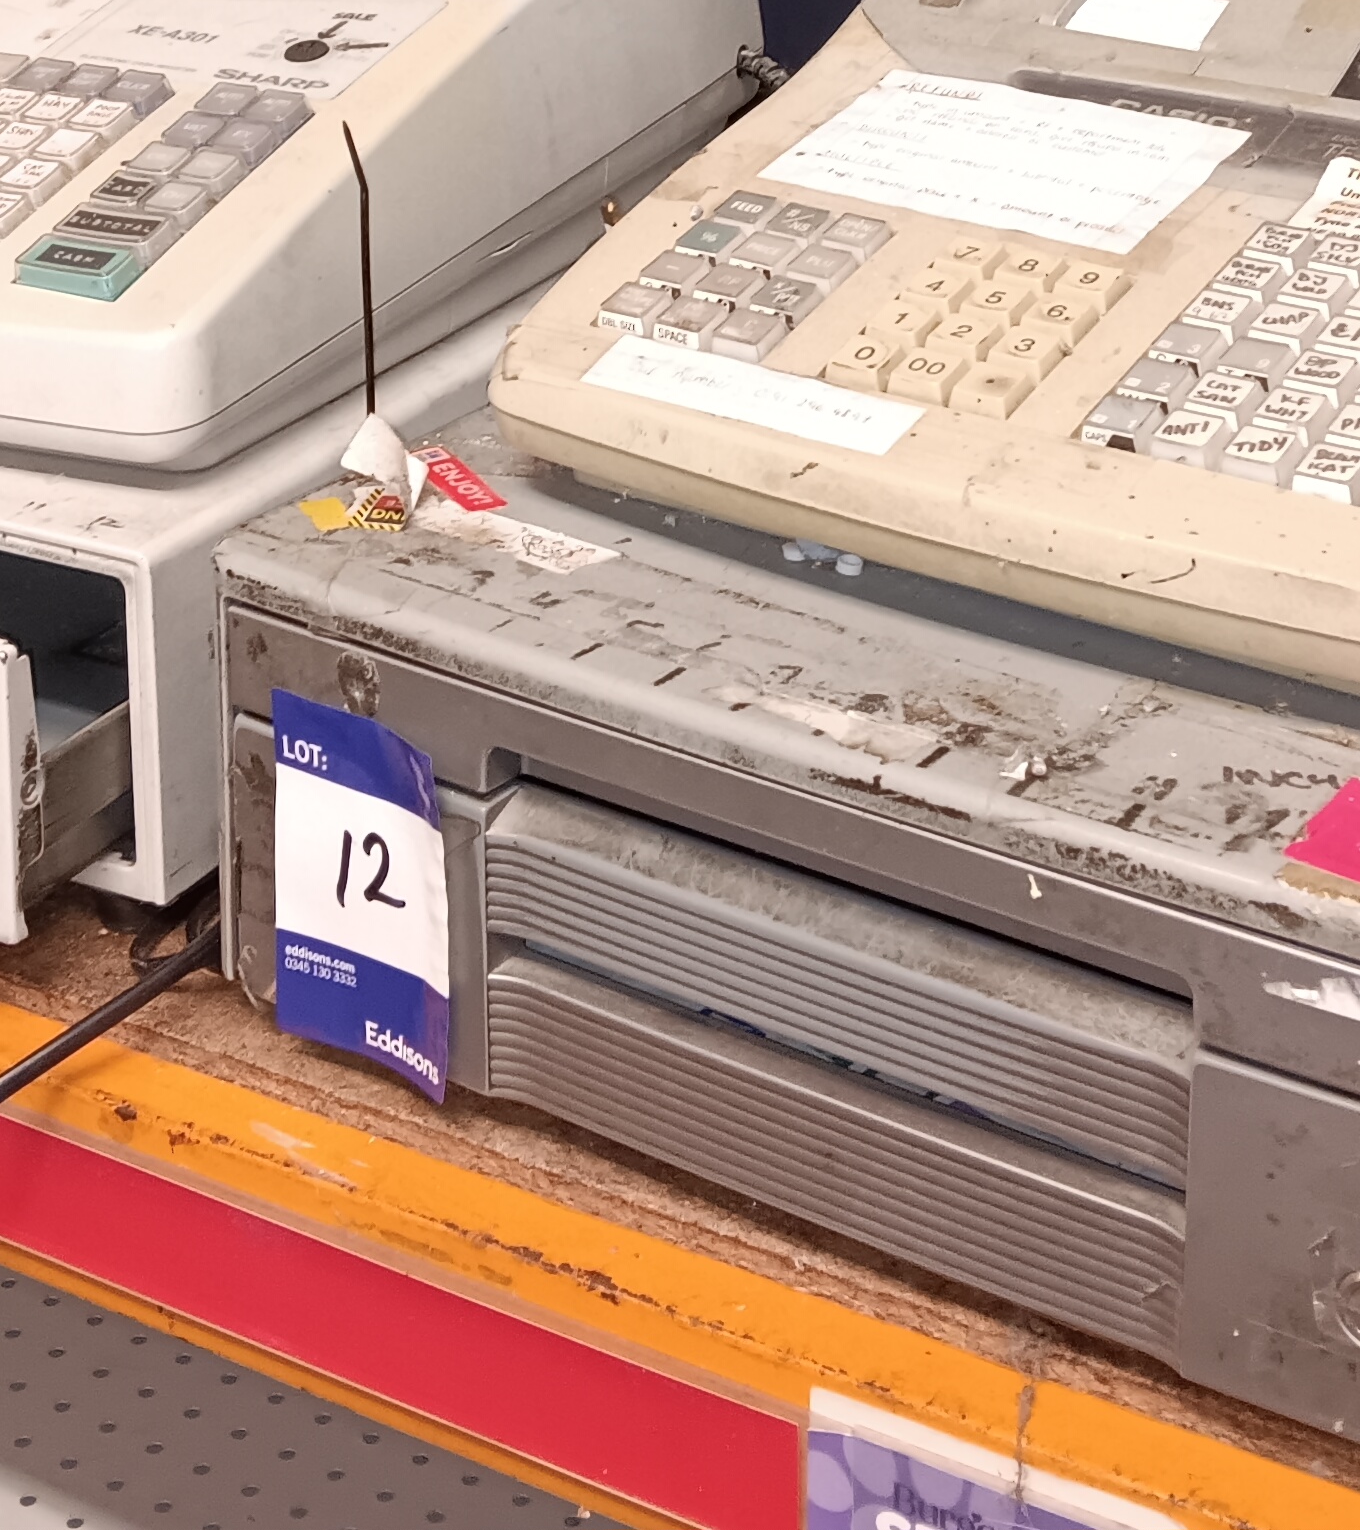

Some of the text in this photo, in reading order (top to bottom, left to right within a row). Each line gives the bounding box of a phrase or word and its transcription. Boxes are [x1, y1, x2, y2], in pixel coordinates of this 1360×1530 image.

[331, 12, 378, 21] SALE
[128, 24, 220, 44] XE-A301
[214, 68, 330, 90] SHARP
[730, 200, 764, 214] FEED
[69, 215, 151, 232] SUBTOTAL
[954, 246, 980, 259] 7
[1019, 259, 1039, 272] 8
[925, 279, 945, 292] 4
[1080, 272, 1100, 285] 9
[985, 291, 1006, 304] 5
[1047, 304, 1068, 317] 6
[895, 312, 909, 324] 1
[657, 327, 688, 345] SPACE
[950, 325, 973, 338] 2
[1014, 338, 1036, 352] 3
[854, 346, 875, 360] 0
[908, 357, 946, 375] 00
[1206, 379, 1241, 392] CAT
[1194, 390, 1237, 404] SAN
[1162, 420, 1210, 436] ANTI
[1232, 436, 1287, 453] TIDY
[431, 461, 494, 507] ENJOY!
[282, 735, 327, 771] LOT:
[336, 829, 406, 908] 12
[285, 943, 355, 974] eddisons.com
[285, 957, 357, 988] 0345 130 3332
[365, 1019, 440, 1086] Eddisons
